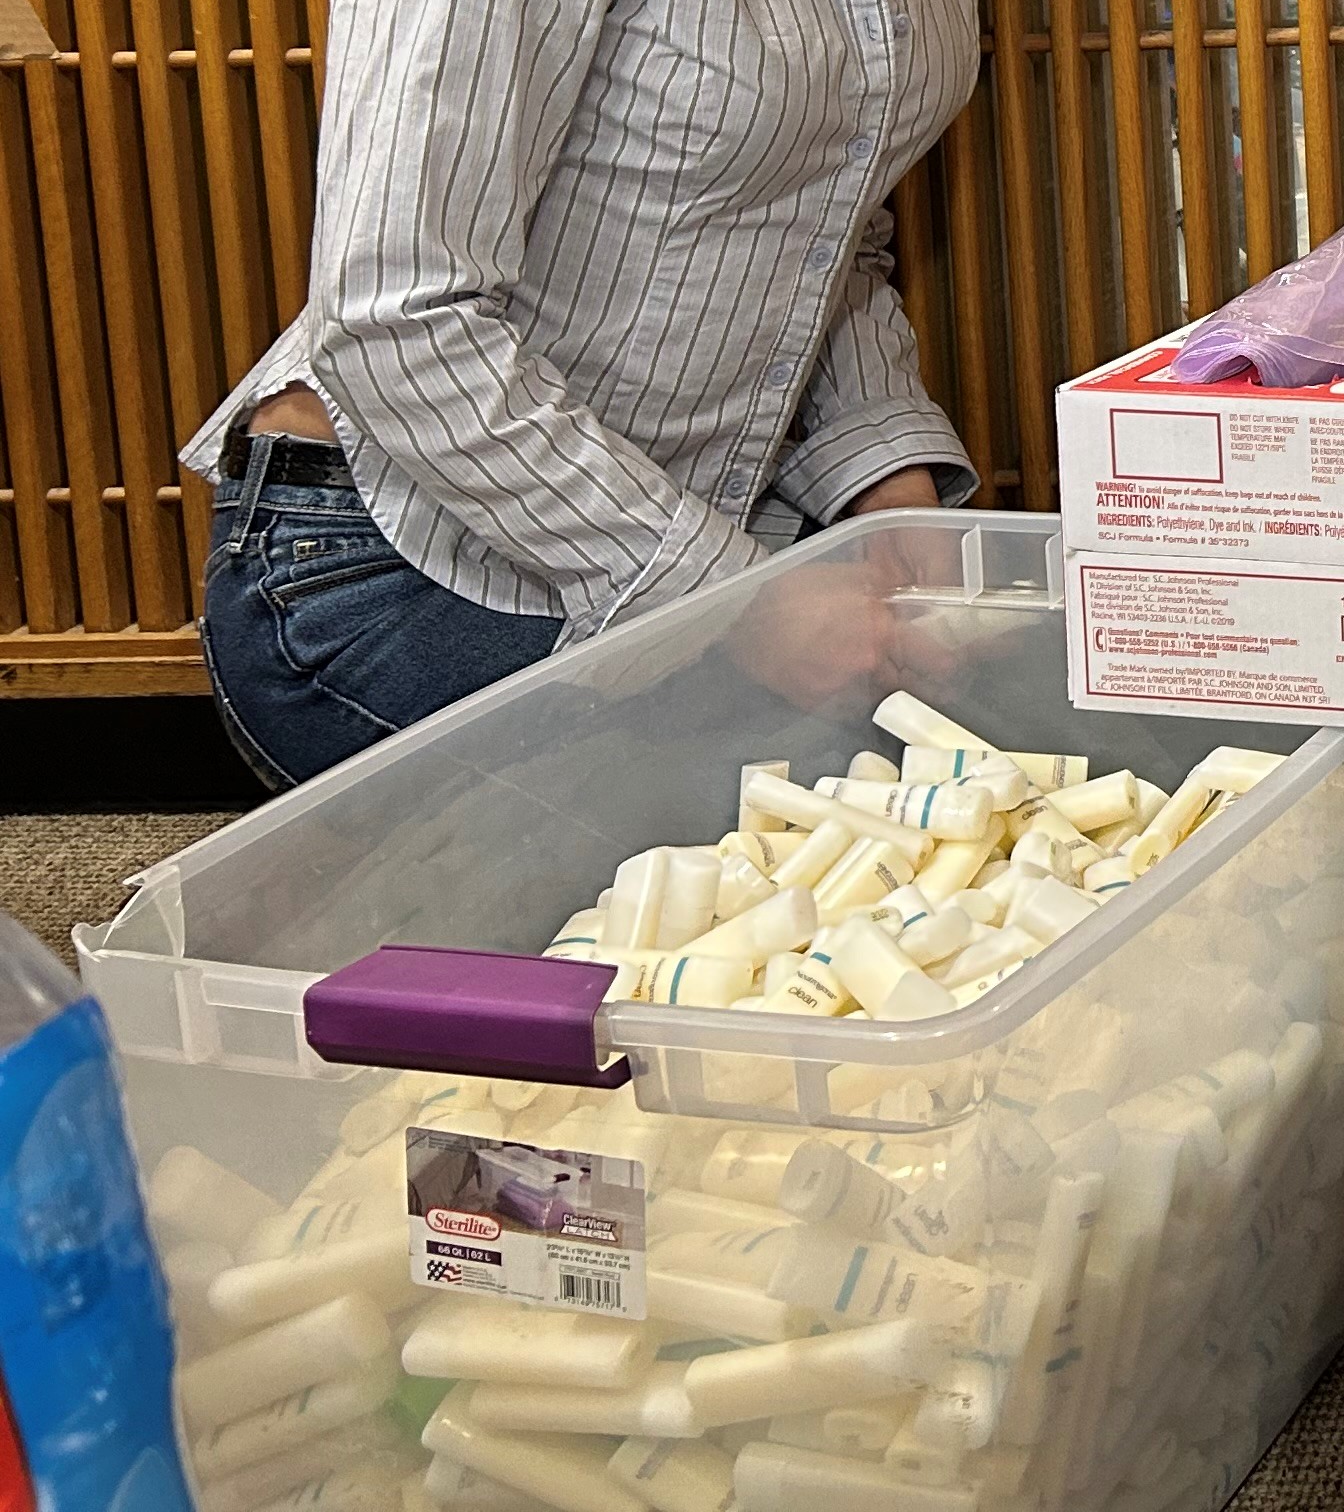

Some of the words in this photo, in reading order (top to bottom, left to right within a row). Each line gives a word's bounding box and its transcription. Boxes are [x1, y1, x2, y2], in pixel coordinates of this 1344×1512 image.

[1096, 481, 1136, 493] WARNING!
[1163, 486, 1182, 497] danger
[1225, 489, 1239, 499] keep
[1297, 493, 1322, 502] children.
[1096, 493, 1165, 510] ATTENTION!
[1098, 513, 1156, 529] INGREDIENTS:
[1156, 515, 1207, 533] Polyethylene,
[1209, 518, 1224, 534] Dye
[1226, 520, 1241, 533] and
[1242, 520, 1256, 533] Ink.
[1264, 519, 1323, 537] INGRÉDIENTS:
[1098, 531, 1117, 541] SCJ
[1118, 532, 1154, 543] Formula
[1162, 534, 1198, 545] Formula
[1089, 571, 1137, 582] Manufactured
[1153, 575, 1166, 583] S.C.
[1167, 576, 1197, 585] Johnson
[1197, 577, 1240, 587] Professional
[1096, 583, 1124, 591] Division
[1147, 585, 1178, 594] Johnson
[1184, 586, 1199, 596] Son,
[1091, 601, 1105, 610] Une
[1106, 602, 1133, 611] division
[1134, 604, 1143, 612] de
[1158, 605, 1188, 615] Johnson
[1195, 607, 1210, 616] Son,
[1157, 595, 1186, 604] Johnson
[1186, 597, 1229, 607] Professional
[1091, 611, 1116, 621] Racine,
[1168, 614, 1189, 624] U.S.A.
[1239, 643, 1270, 656] (Canada)
[1108, 662, 1128, 673] Trade
[1129, 664, 1148, 674] Mark
[1149, 666, 1174, 675] owned
[1238, 671, 1267, 682] Marque
[1268, 672, 1278, 682] de
[1279, 674, 1318, 684] commerce
[1101, 673, 1146, 684] appartenant
[1187, 678, 1203, 687] PAR
[1256, 682, 1273, 692] AND
[1110, 683, 1147, 693] JOHNSON
[1268, 692, 1301, 703] CANADA
[788, 986, 819, 1009] clean
[434, 1212, 493, 1236] Sterilite
[563, 1213, 613, 1231] ClearView
[567, 1225, 610, 1240] LATCH
[484, 1252, 492, 1262] L
